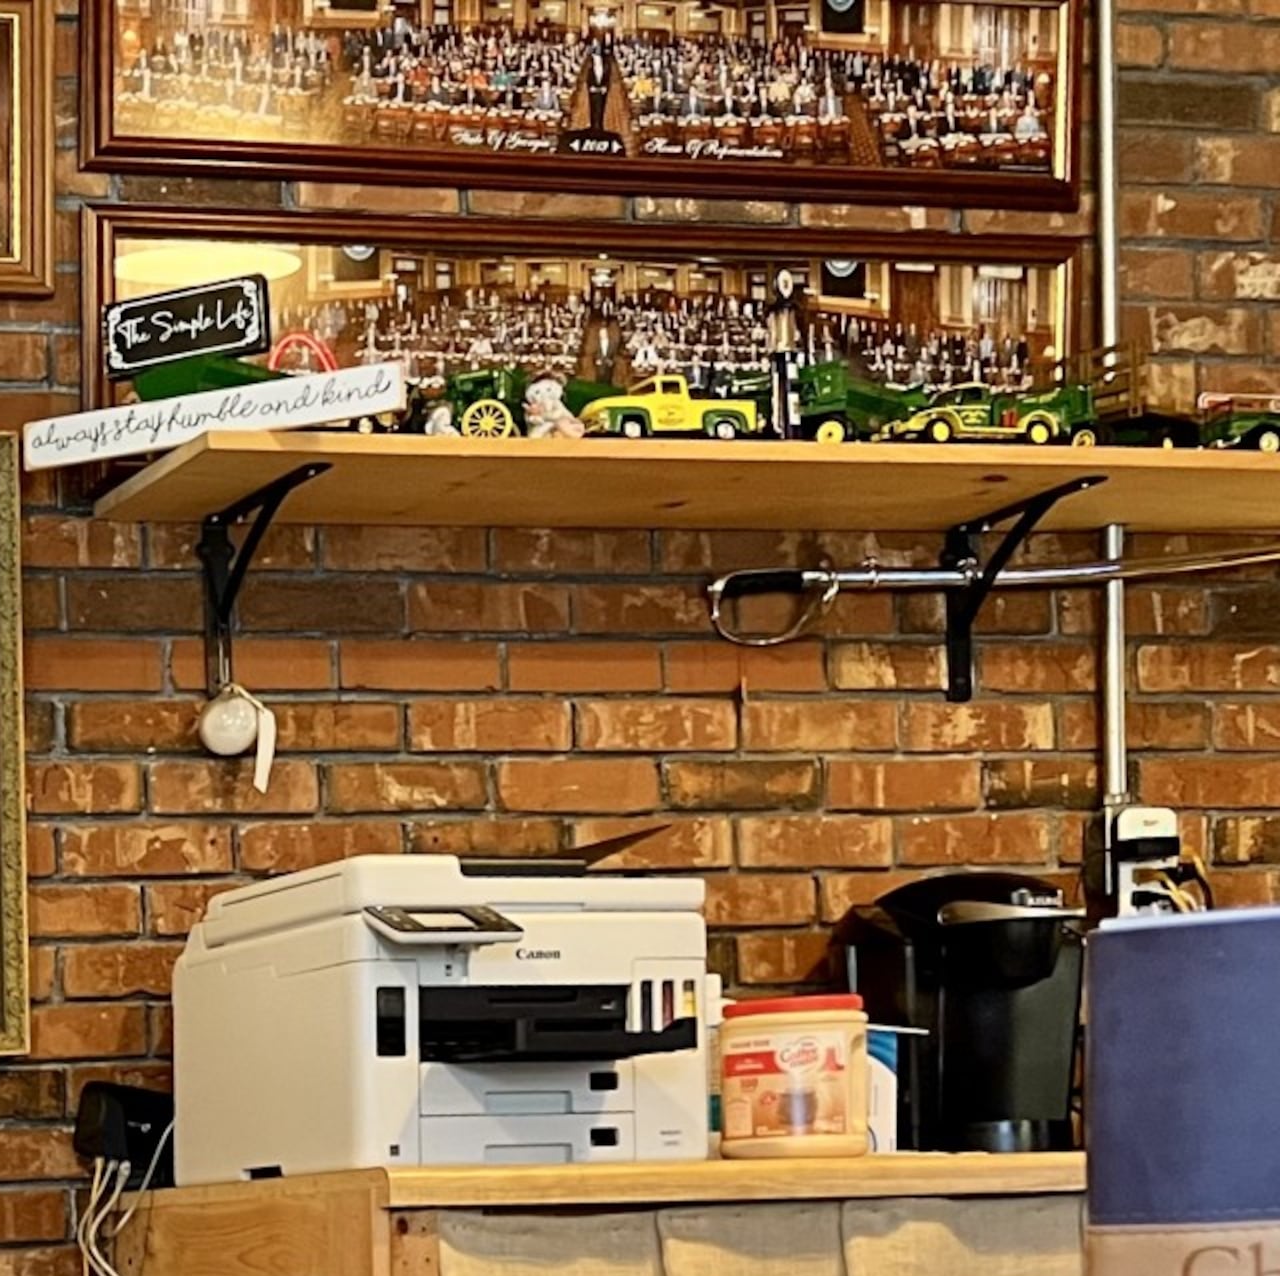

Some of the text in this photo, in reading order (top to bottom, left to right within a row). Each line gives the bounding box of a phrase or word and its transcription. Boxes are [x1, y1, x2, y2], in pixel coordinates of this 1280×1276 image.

[117, 299, 253, 349] The Simple Life
[31, 369, 392, 453] always stay humble and kind
[515, 948, 561, 961] Canon
